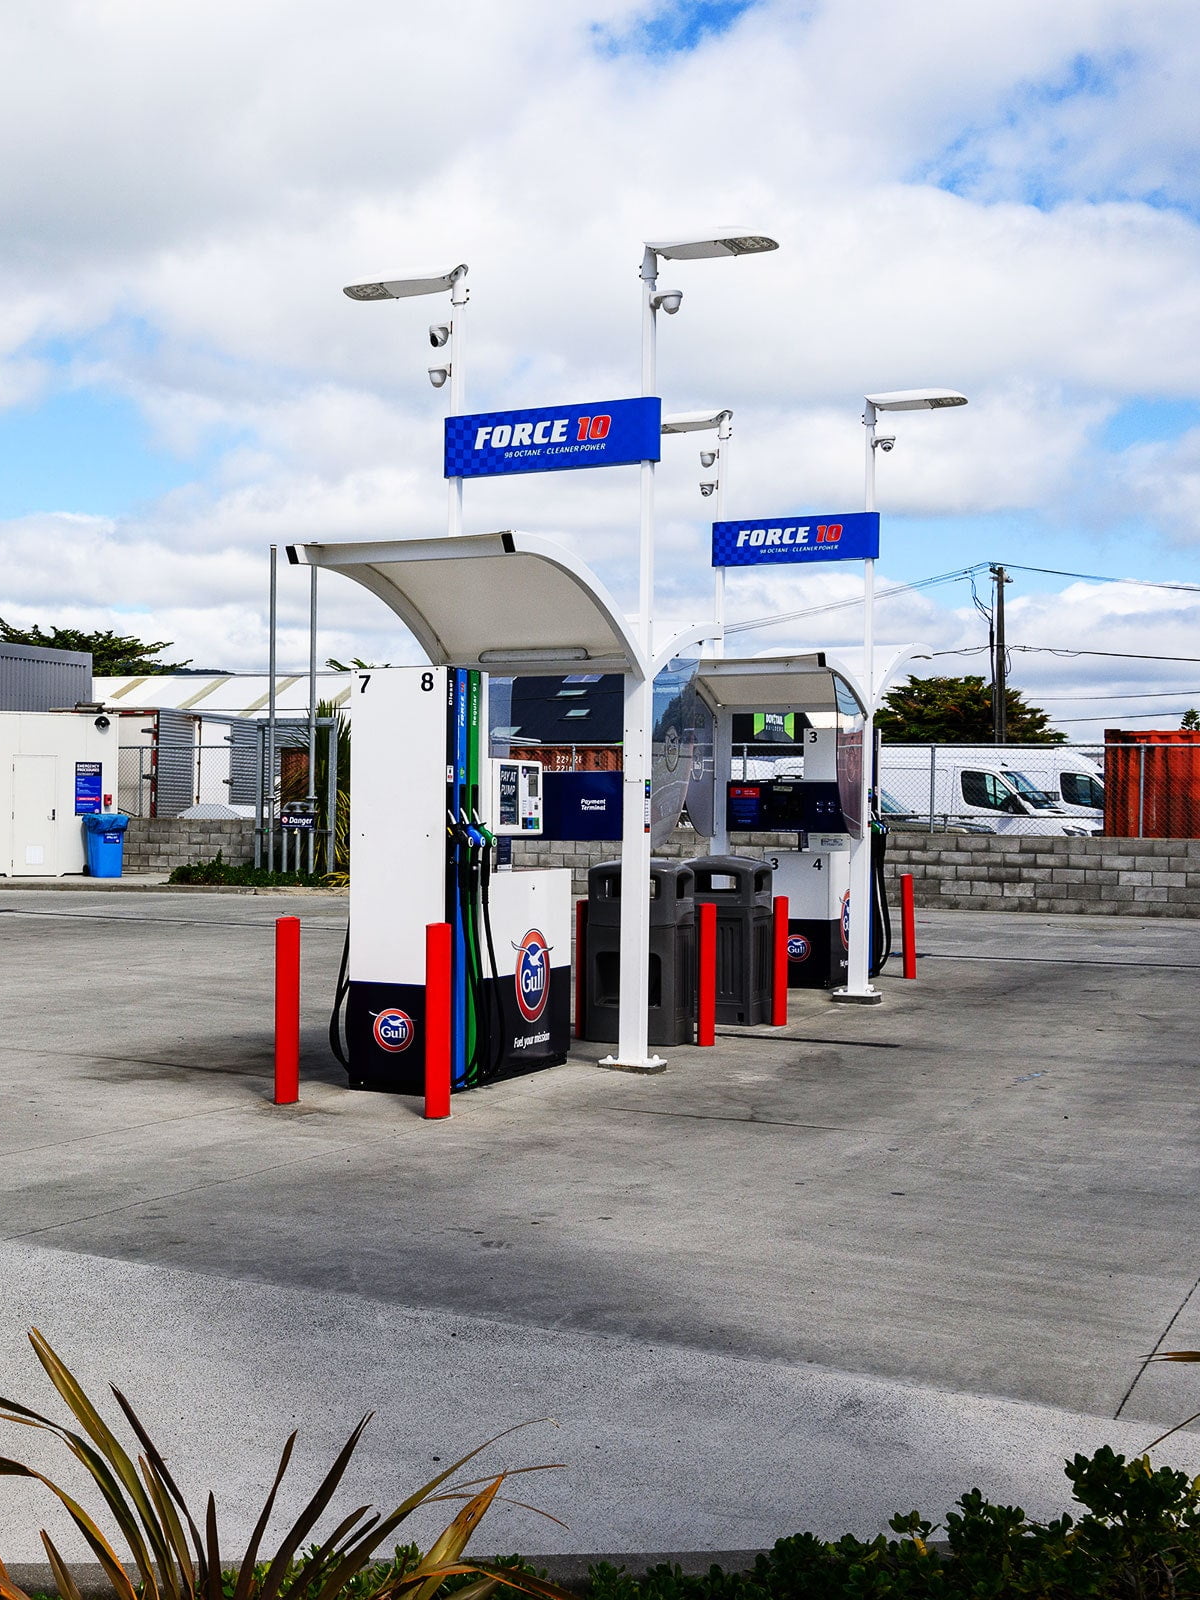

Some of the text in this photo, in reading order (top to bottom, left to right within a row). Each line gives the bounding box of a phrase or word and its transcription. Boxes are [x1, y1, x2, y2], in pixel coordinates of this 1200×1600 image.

[474, 415, 612, 450] FORCE 10
[514, 449, 541, 457] OCTANE
[546, 445, 580, 455] CLEANER
[580, 443, 606, 452] POWER
[736, 524, 843, 547] FORCE 10
[359, 675, 371, 693] 7
[421, 672, 434, 692] 8
[809, 731, 818, 743] 3
[500, 770, 517, 782] PAY AT
[500, 784, 516, 795] PUMP
[581, 798, 606, 806] Payment
[289, 817, 313, 826] Danger
[770, 858, 779, 870] 3
[813, 858, 822, 870] 4
[522, 966, 544, 993] Gull
[380, 1026, 406, 1039] Gull
[513, 1030, 550, 1049] Fuel your mission
